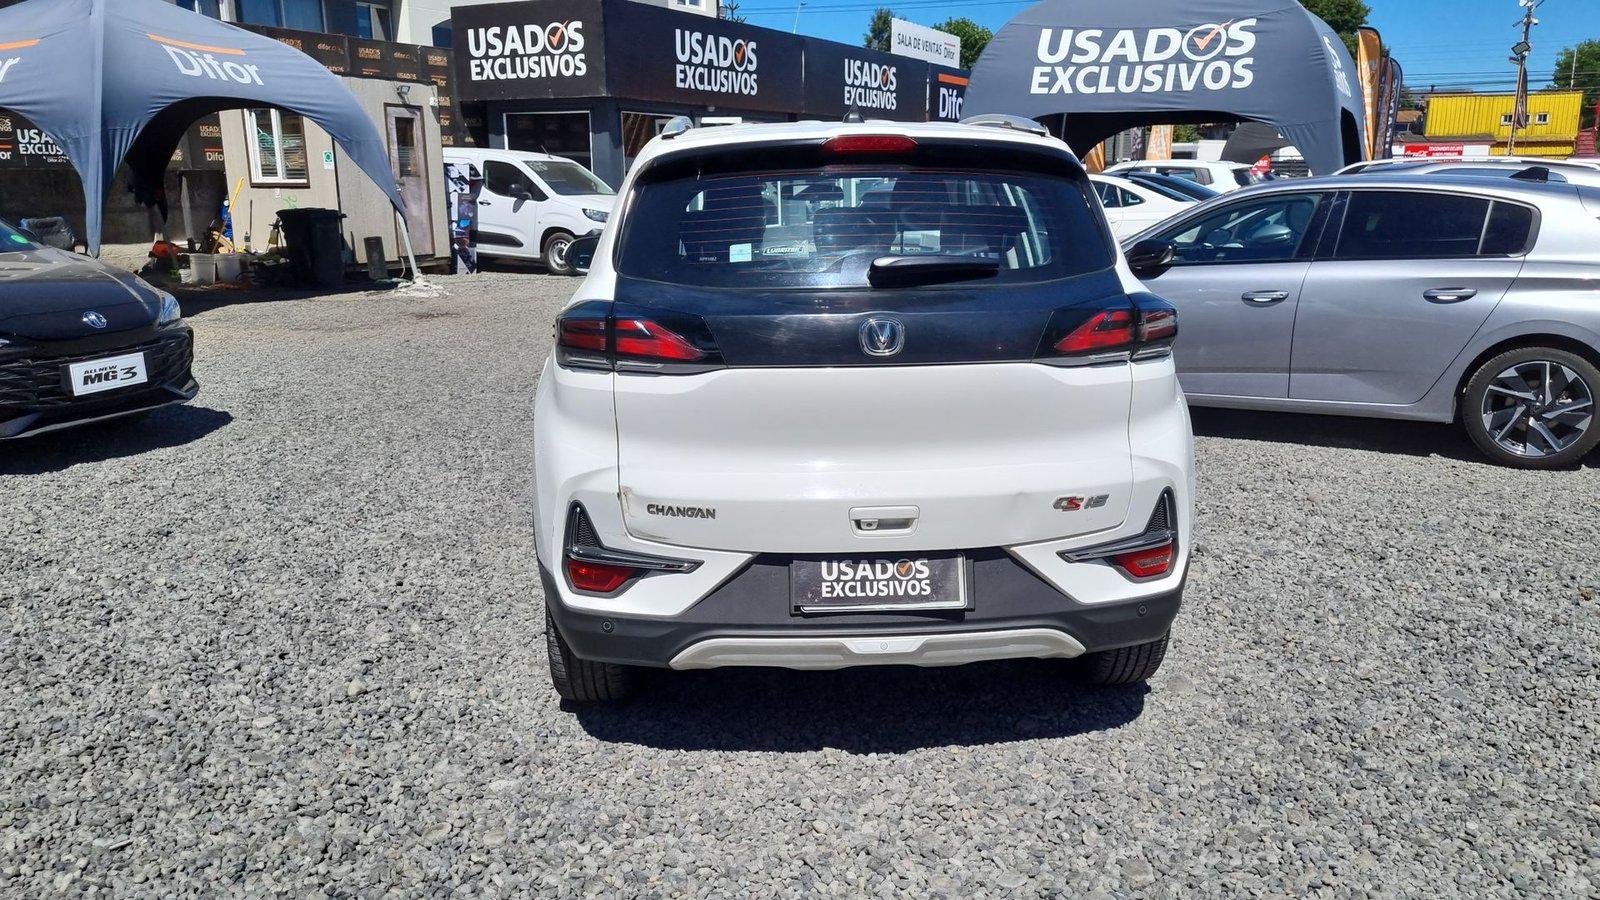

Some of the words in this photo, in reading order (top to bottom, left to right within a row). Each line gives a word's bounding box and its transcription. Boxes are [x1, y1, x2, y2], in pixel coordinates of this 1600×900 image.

[467, 20, 585, 57] USADOS
[675, 28, 758, 72] USADOS
[897, 33, 912, 48] SALA
[913, 37, 921, 50] DE
[922, 40, 942, 55] VENTAS
[1036, 18, 1257, 64] USADOS
[161, 44, 265, 86] Difor
[470, 53, 587, 81] EXCLUSIVOS
[676, 64, 758, 96] EXCLUSIVOS
[844, 58, 897, 91] USADOS
[1030, 57, 1254, 94] EXCLUSIVOS
[844, 86, 897, 110] EXCLUSIVOS
[82, 370, 118, 386] MG
[646, 503, 716, 519] CHANGAN
[820, 558, 930, 580] USADOS
[821, 579, 932, 597] EXCLUSIVOS
